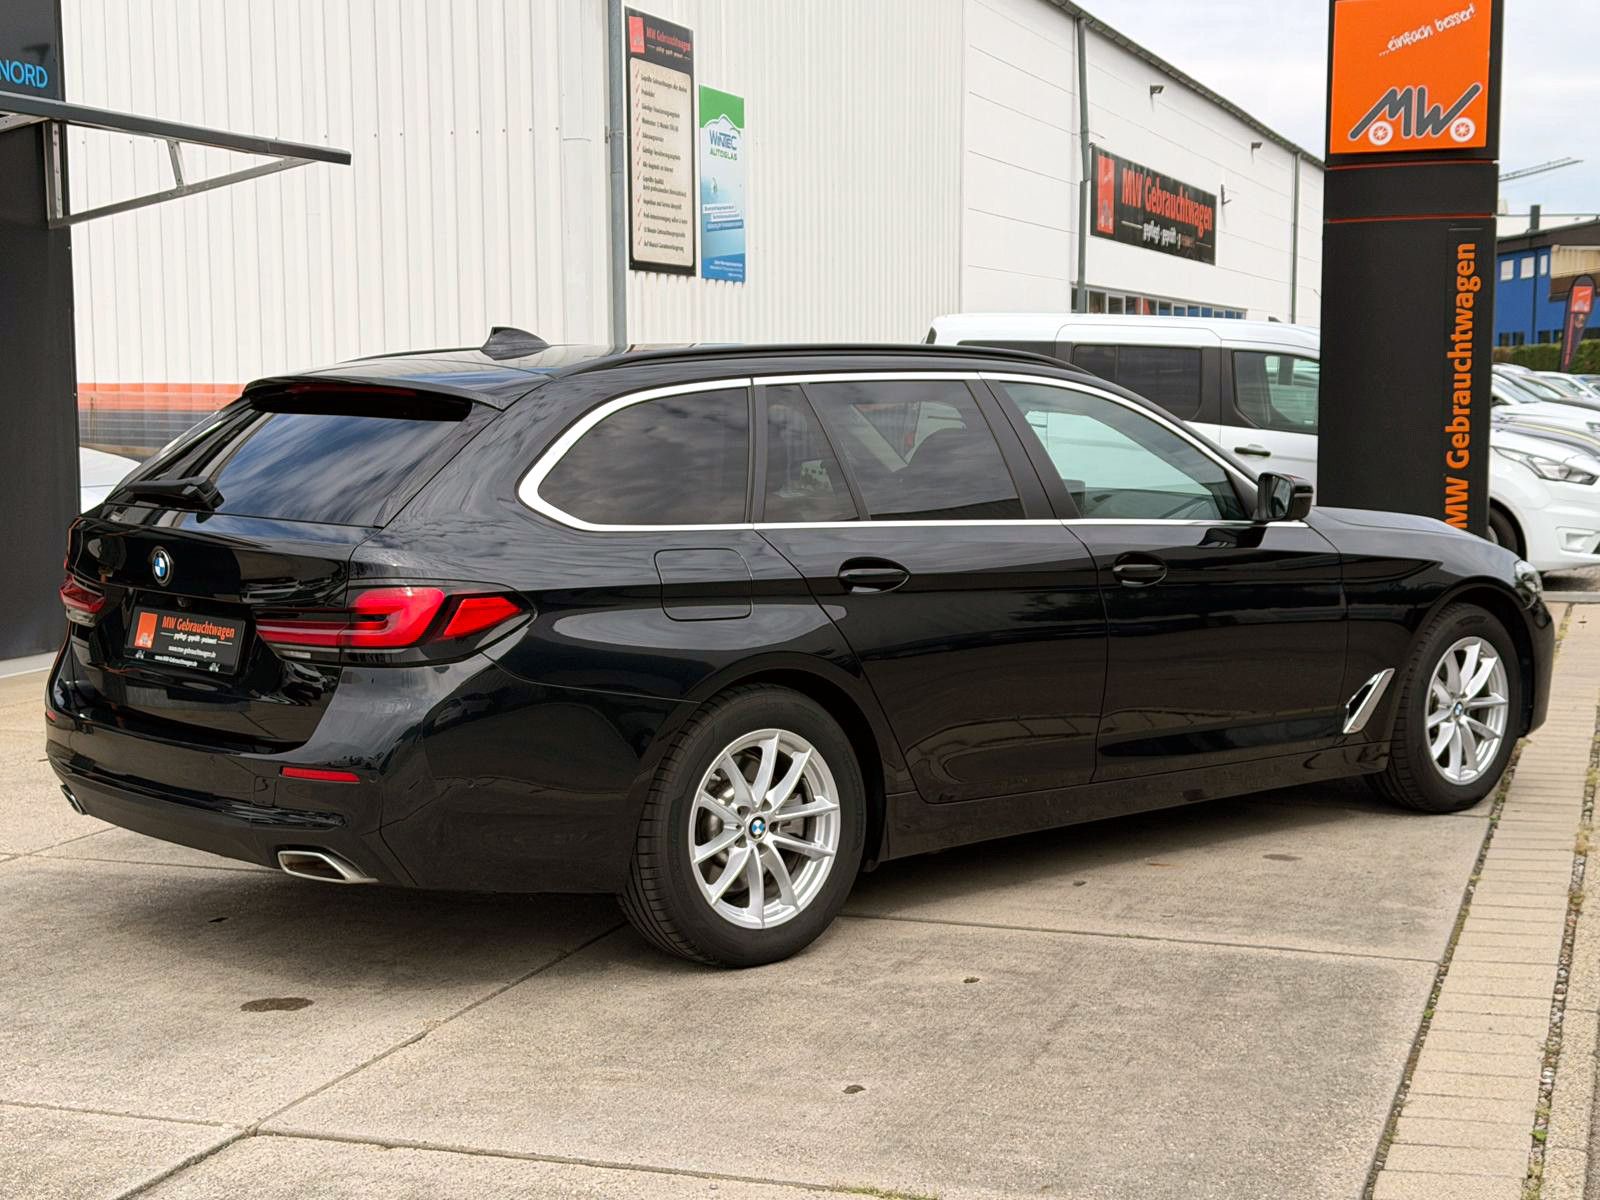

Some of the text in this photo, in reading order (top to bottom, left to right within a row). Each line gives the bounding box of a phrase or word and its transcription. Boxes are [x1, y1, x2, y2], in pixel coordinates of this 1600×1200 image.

[1434, 3, 1476, 32] besser!
[0, 58, 48, 89] NORD
[1348, 81, 1484, 142] MW
[1121, 167, 1213, 239] MW Gebrauchtwagen
[1444, 242, 1482, 529] MW Gebrauchtwagen
[162, 615, 236, 640] MW Gebrauchtwagen
